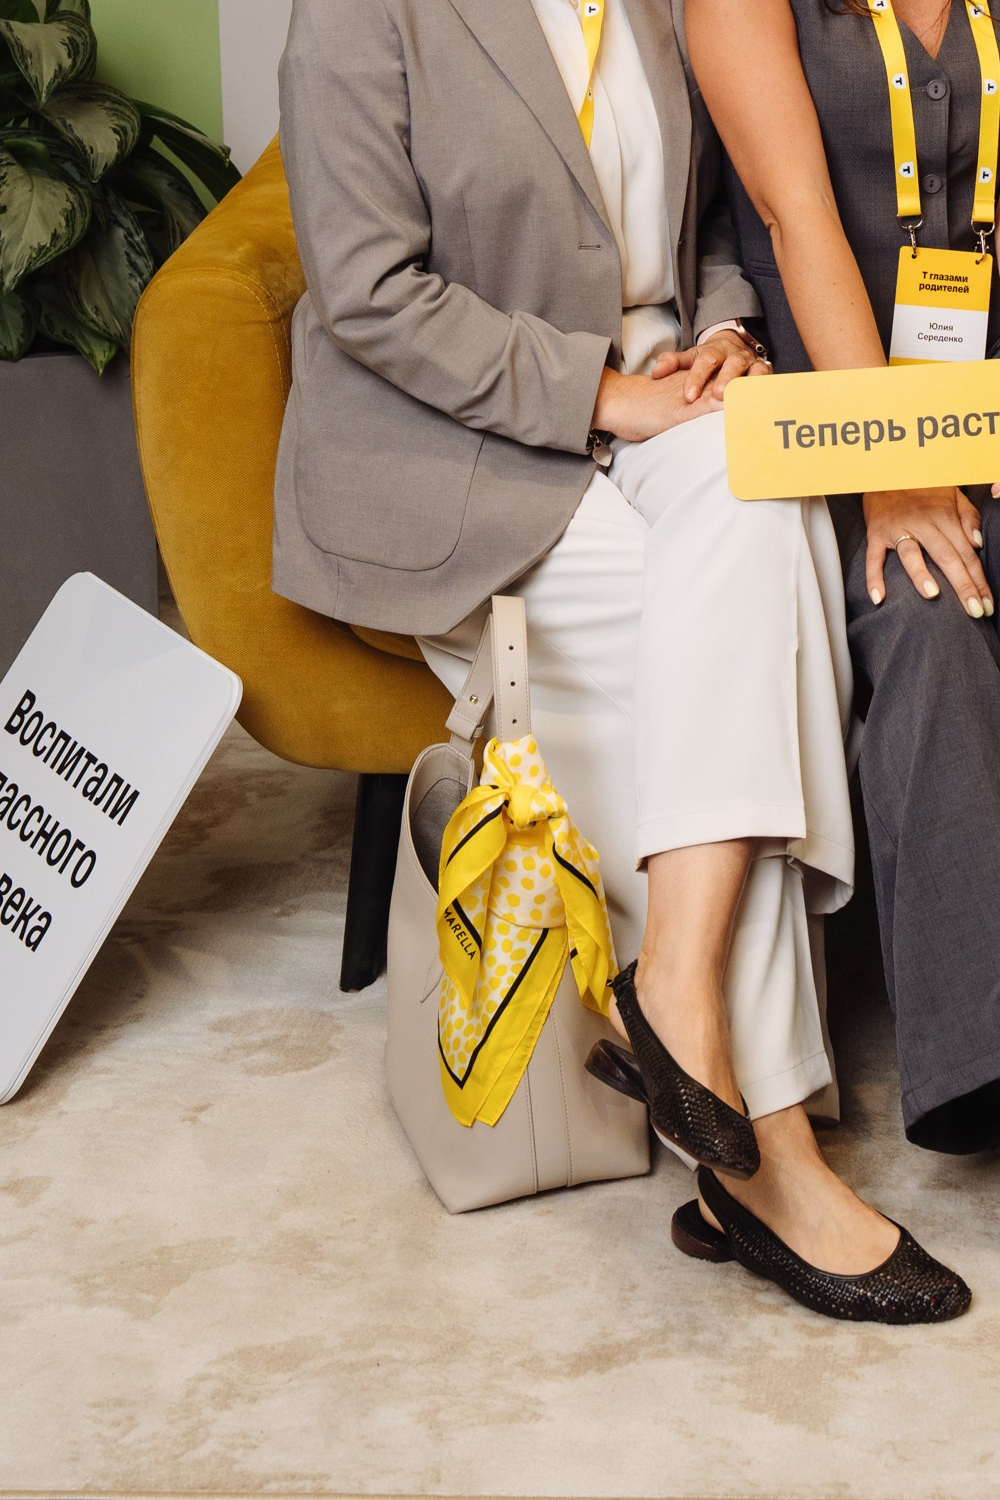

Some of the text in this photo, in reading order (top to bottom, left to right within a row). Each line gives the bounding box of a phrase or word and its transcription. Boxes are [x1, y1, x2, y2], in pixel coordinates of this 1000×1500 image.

[922, 271, 968, 283] Т глазами
[919, 282, 970, 294] родителей
[929, 322, 954, 332] Юлия
[917, 332, 964, 343] Середенко
[774, 419, 907, 451] Теперь
[4, 689, 140, 826] Воспитали
